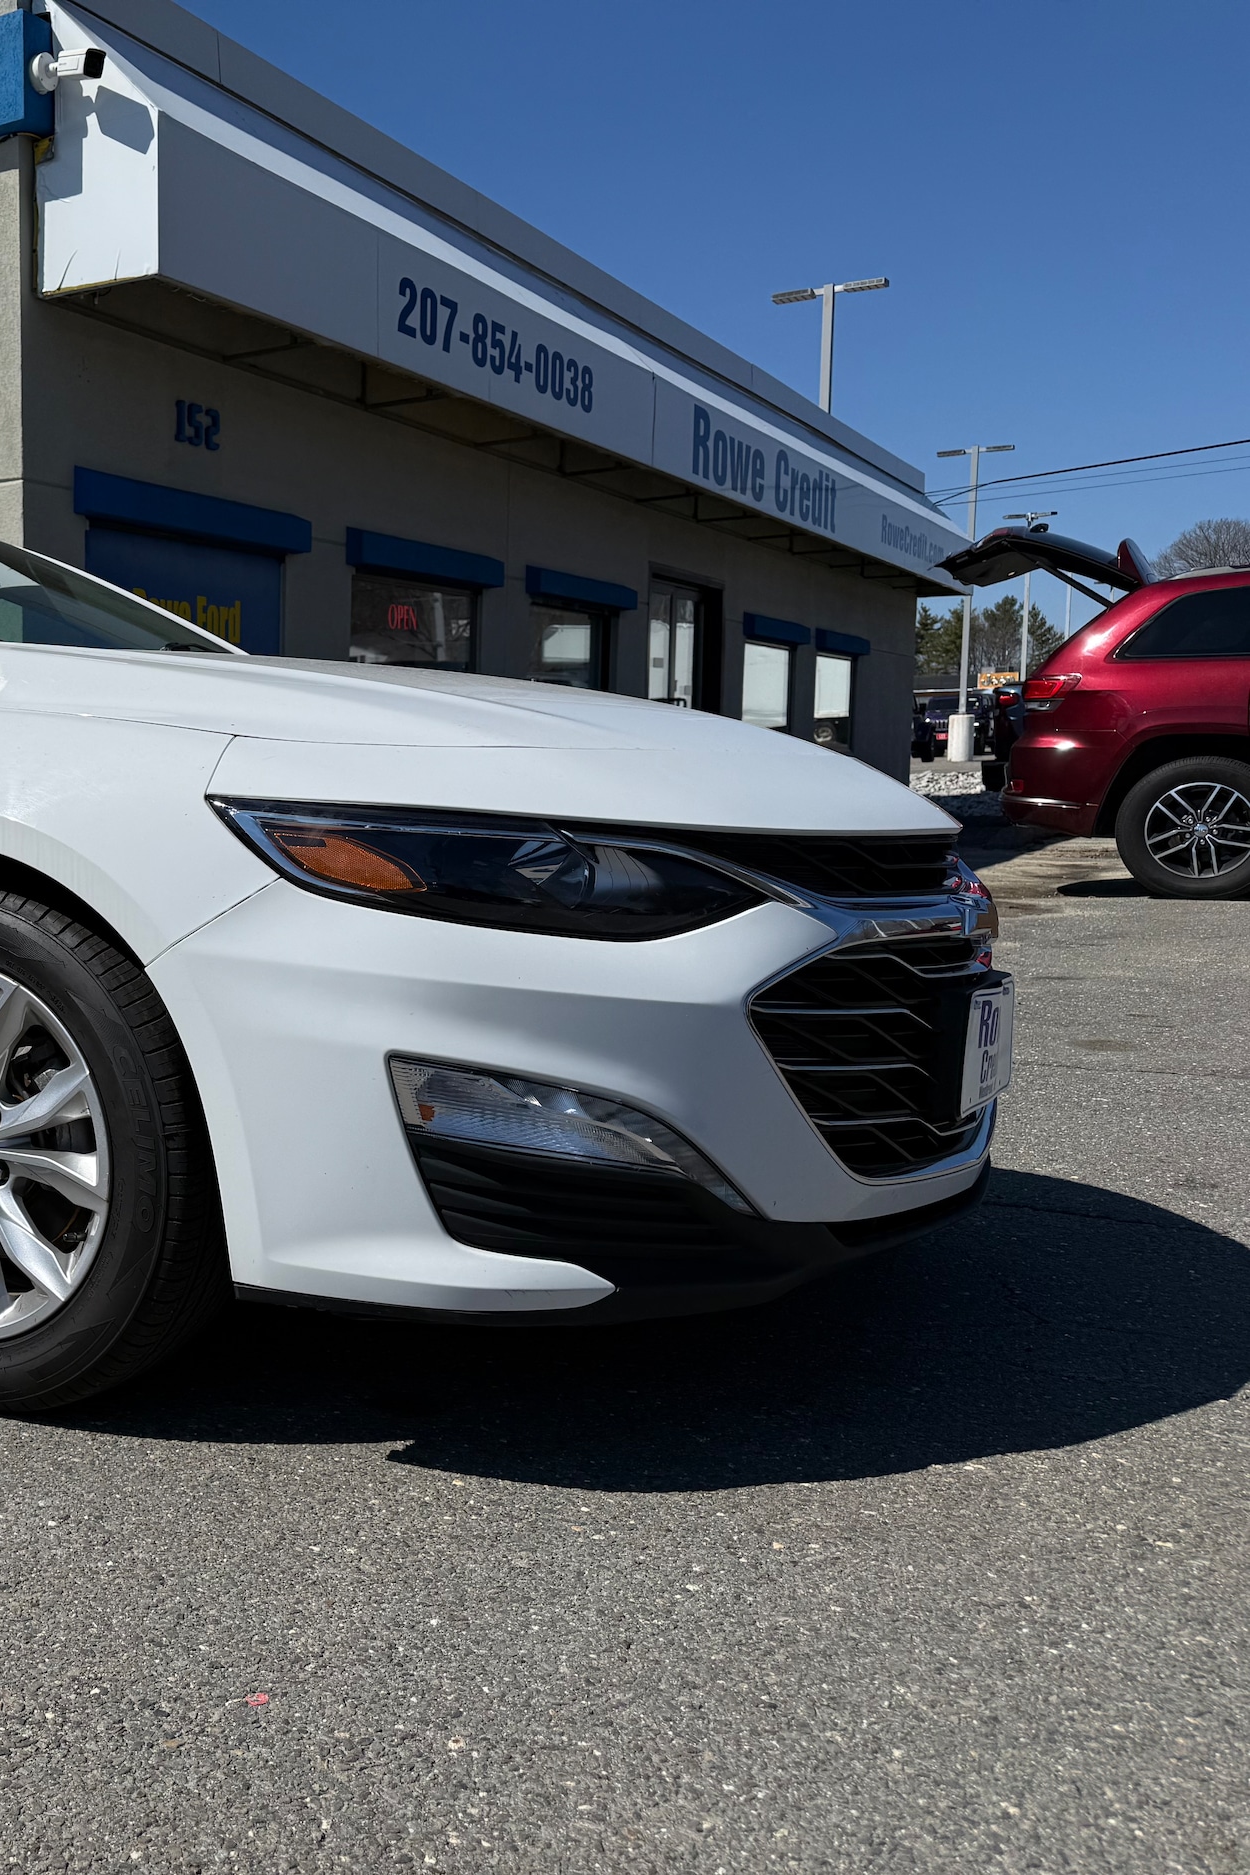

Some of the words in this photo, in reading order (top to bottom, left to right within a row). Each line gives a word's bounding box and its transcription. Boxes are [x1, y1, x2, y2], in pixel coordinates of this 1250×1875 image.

[397, 277, 594, 413] 207-854-0038
[174, 400, 221, 451] 152
[692, 403, 766, 503] Rowe
[774, 449, 837, 534] Credit
[197, 595, 241, 644] Ford
[388, 604, 417, 631] OPEN
